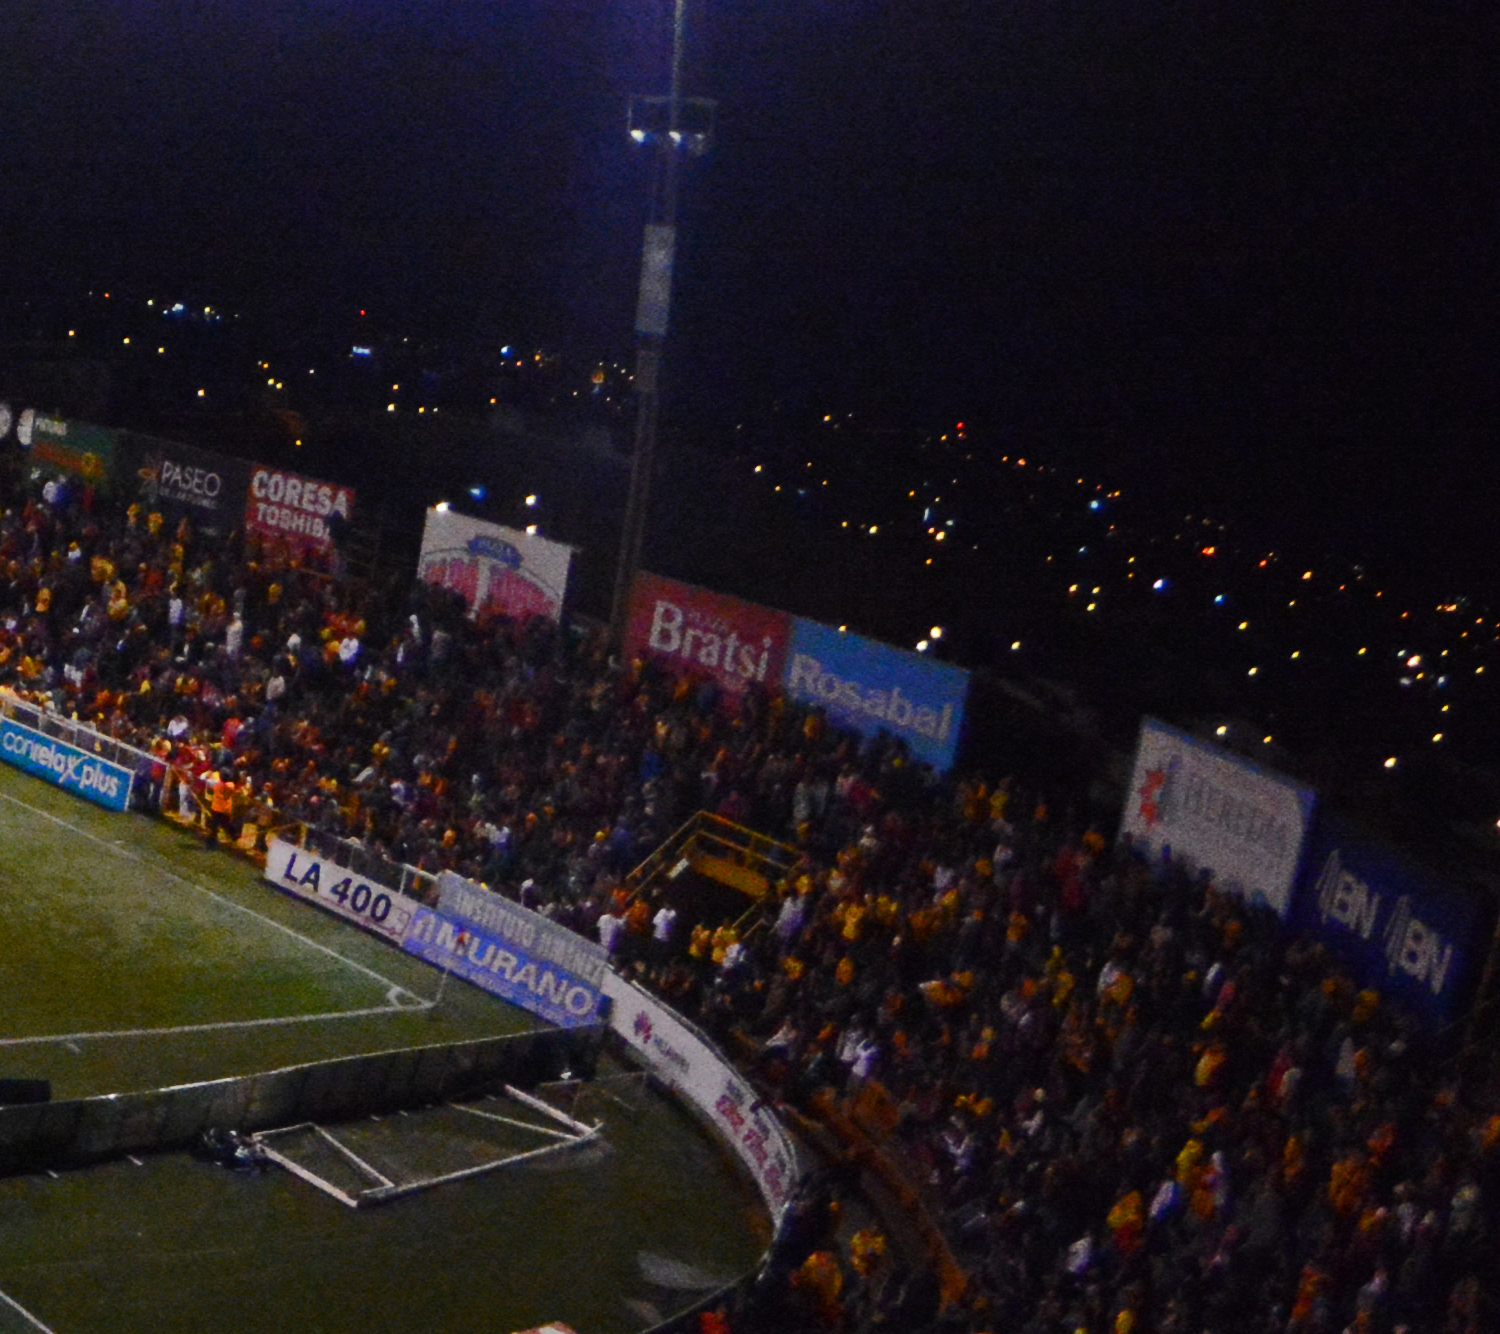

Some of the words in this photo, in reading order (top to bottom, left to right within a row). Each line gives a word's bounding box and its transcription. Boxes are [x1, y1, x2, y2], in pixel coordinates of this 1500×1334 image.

[162, 461, 221, 496] PASEO
[252, 470, 349, 518] CORESA
[648, 600, 773, 683] Bratsi
[80, 761, 120, 798] plus
[285, 854, 321, 893] LA
[331, 878, 392, 923] 400
[436, 919, 594, 1017] MURANO
